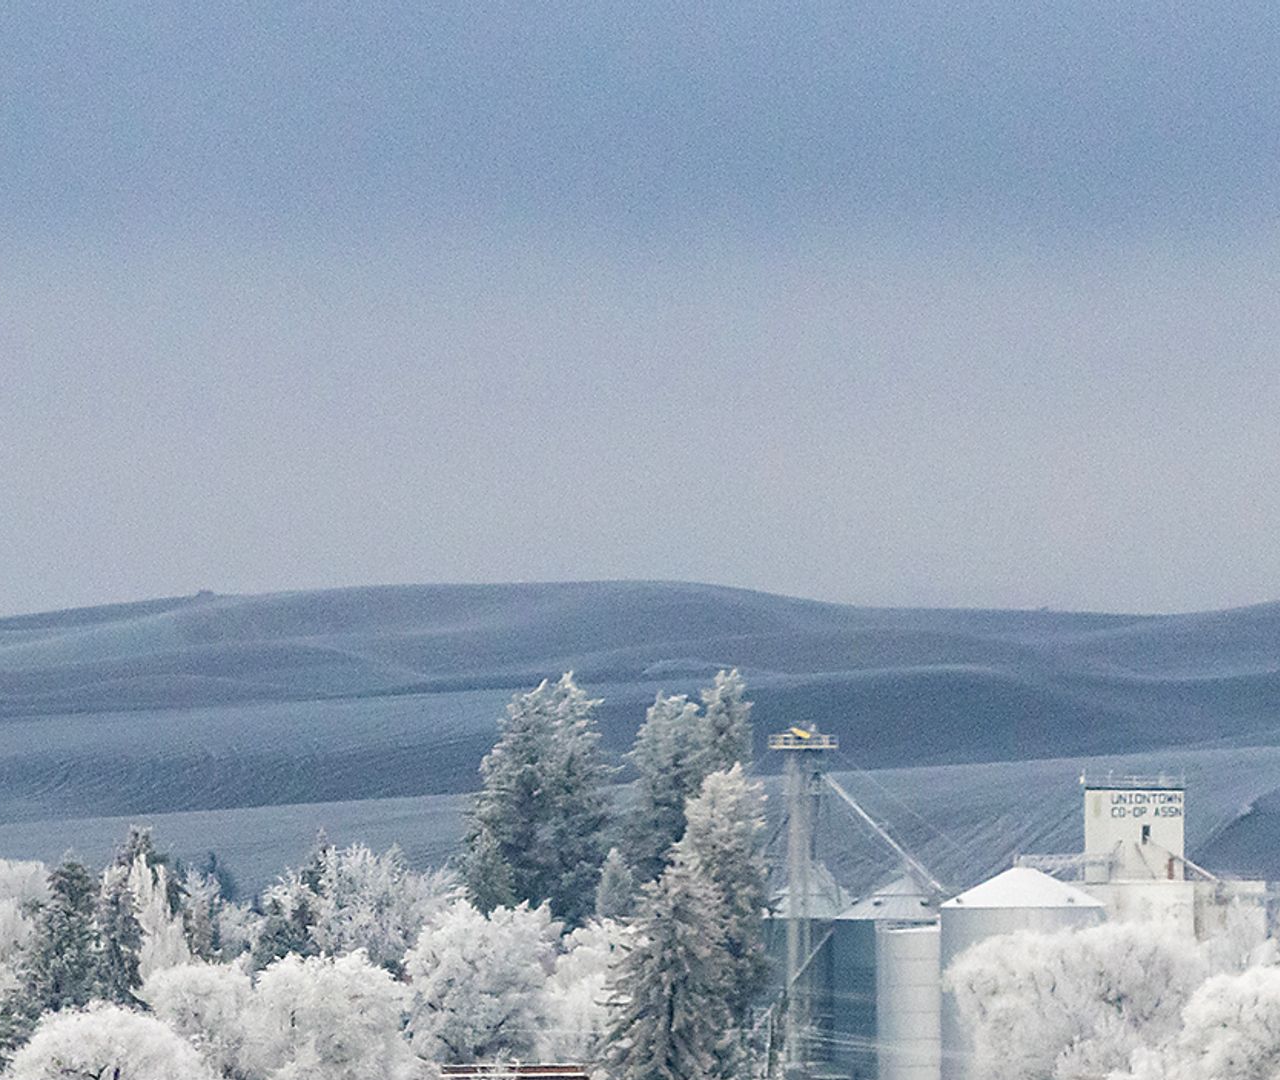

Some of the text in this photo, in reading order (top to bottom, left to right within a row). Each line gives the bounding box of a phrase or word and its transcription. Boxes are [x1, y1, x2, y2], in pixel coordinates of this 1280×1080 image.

[1111, 793, 1182, 805] UNIONTOWN
[1111, 806, 1182, 818] CO-OP ASSN
